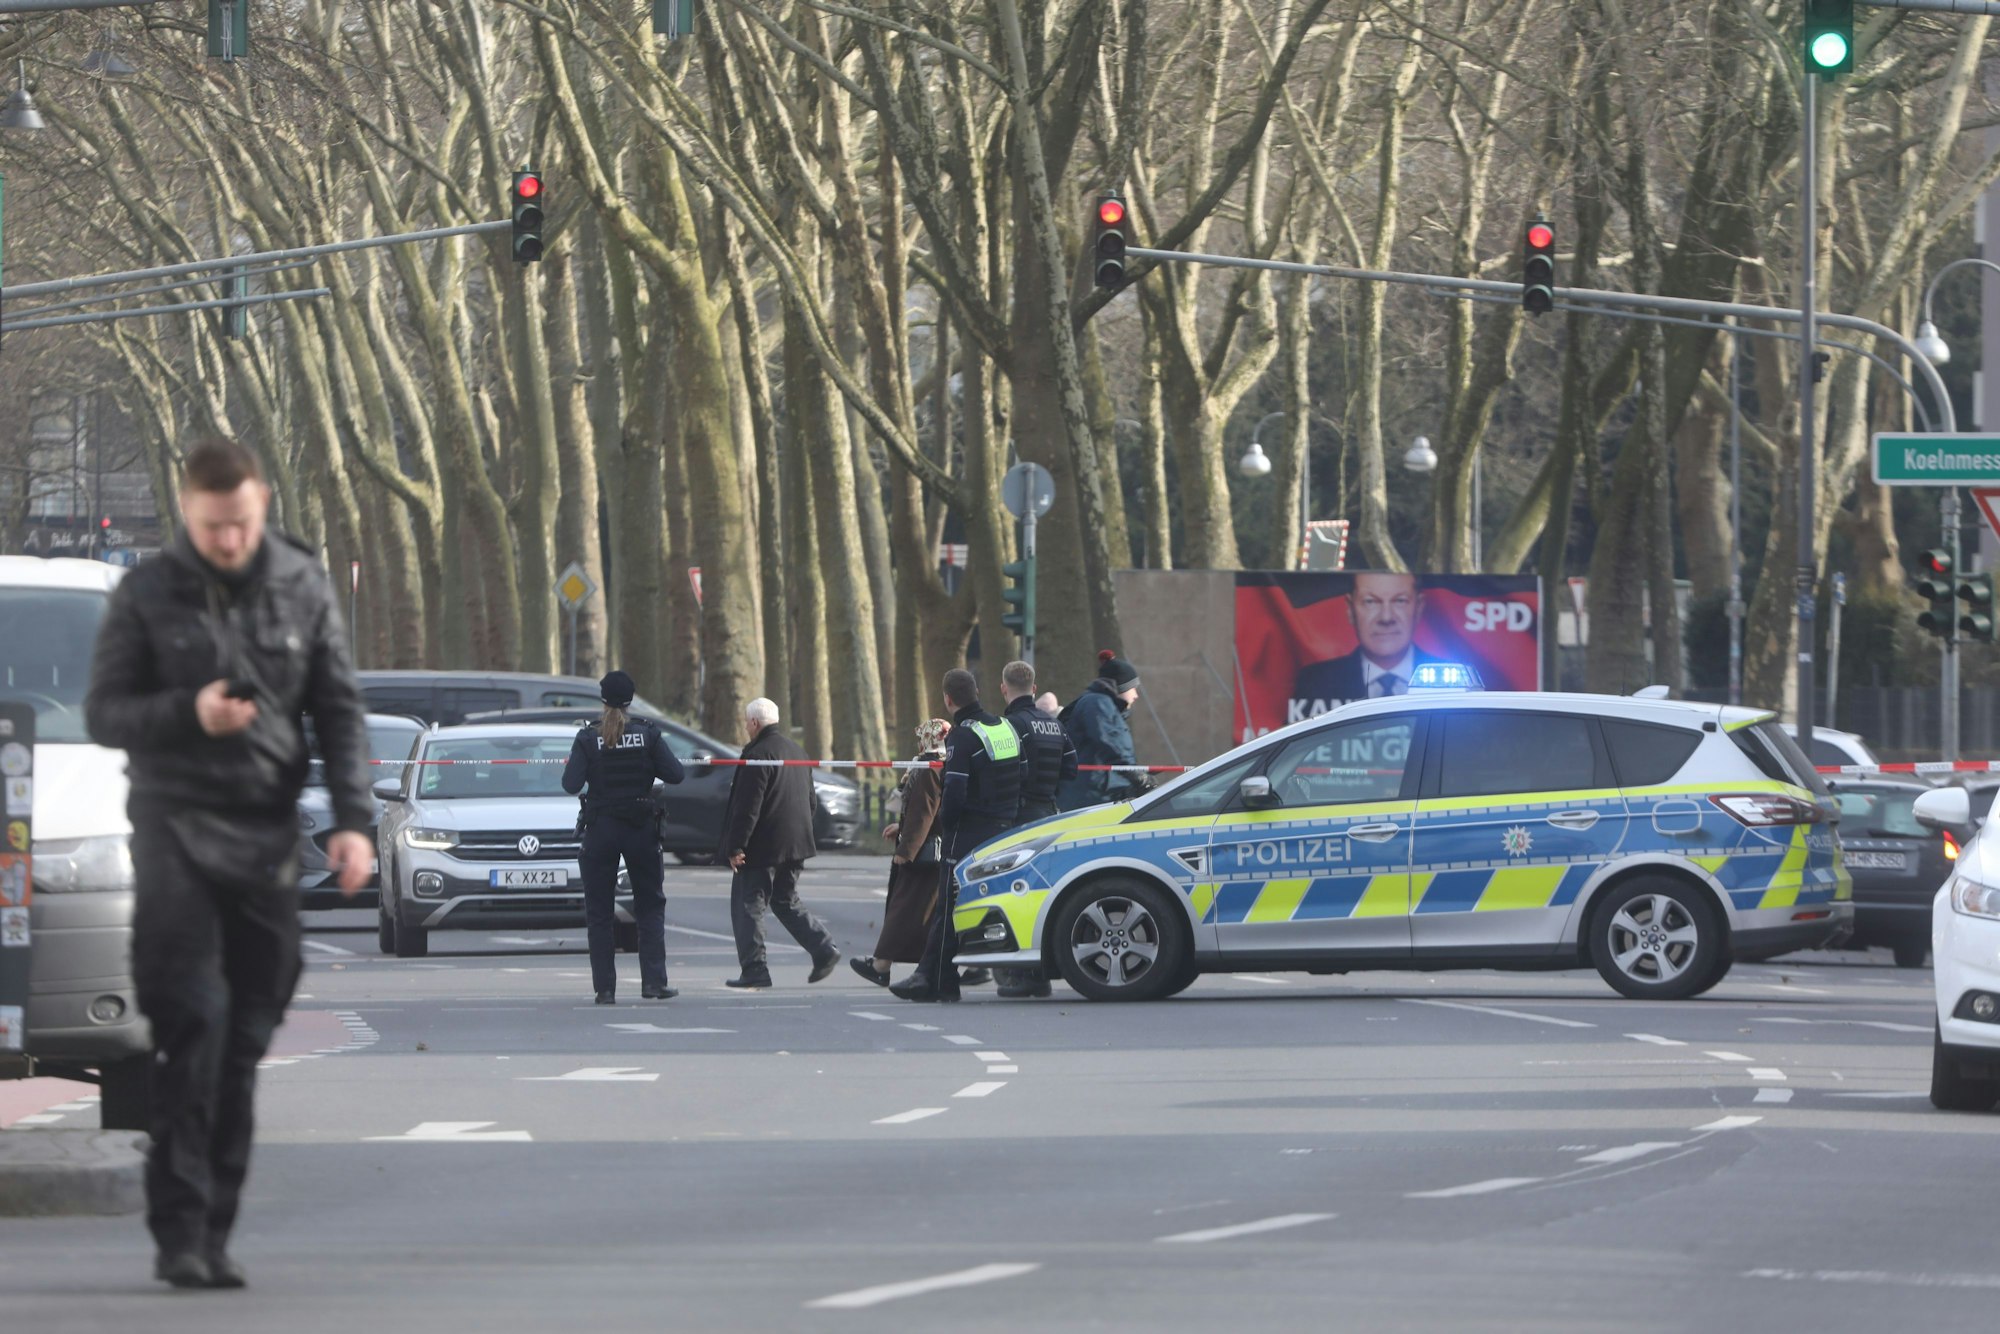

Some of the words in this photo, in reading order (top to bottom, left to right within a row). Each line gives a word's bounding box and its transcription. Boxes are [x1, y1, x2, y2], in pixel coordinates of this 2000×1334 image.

[1464, 601, 1532, 631] SPD
[1031, 720, 1062, 736] POLIZEI
[596, 733, 645, 750] PLIZEI
[993, 737, 1016, 752] POLIZEI
[1340, 739, 1374, 763] IN
[1237, 837, 1351, 866] POLIZEI
[505, 871, 513, 884] K
